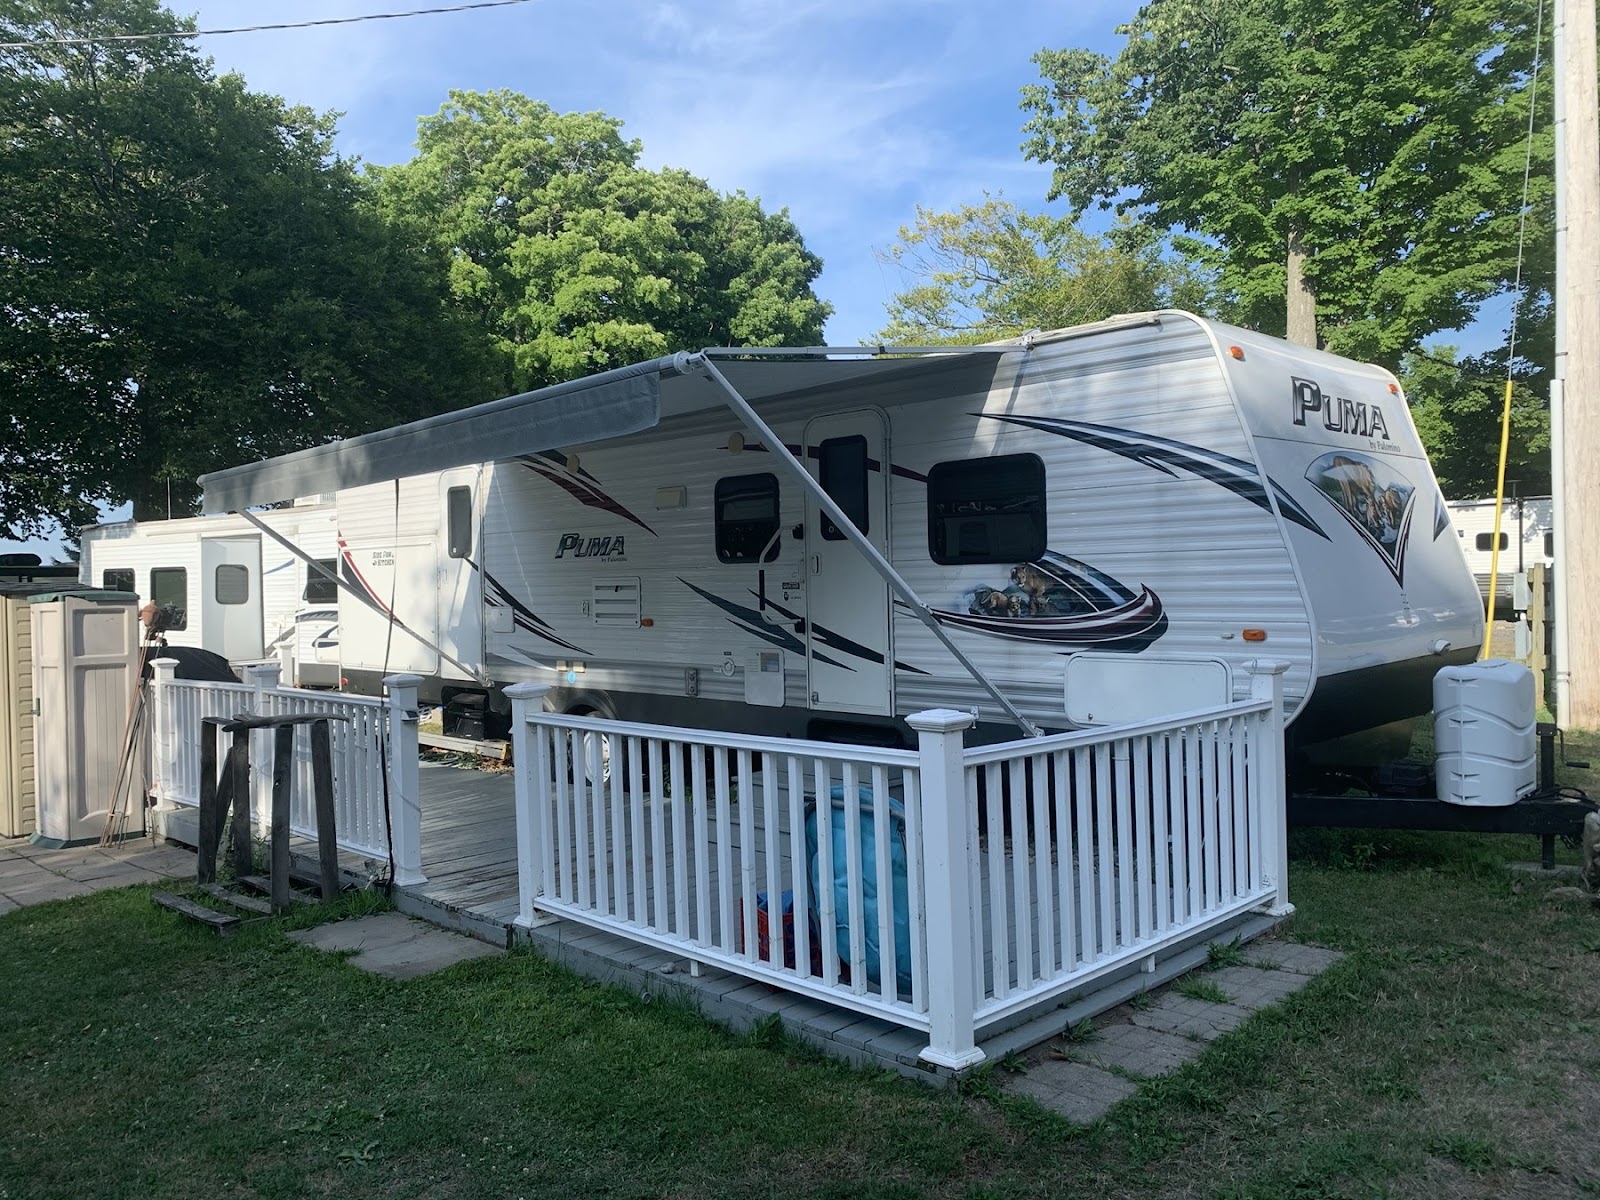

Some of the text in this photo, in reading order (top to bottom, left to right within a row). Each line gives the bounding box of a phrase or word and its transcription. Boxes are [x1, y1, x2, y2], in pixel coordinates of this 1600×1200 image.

[1290, 375, 1390, 441] PUMA
[1369, 440, 1401, 453] by Palomino
[554, 533, 625, 559] PUMA
